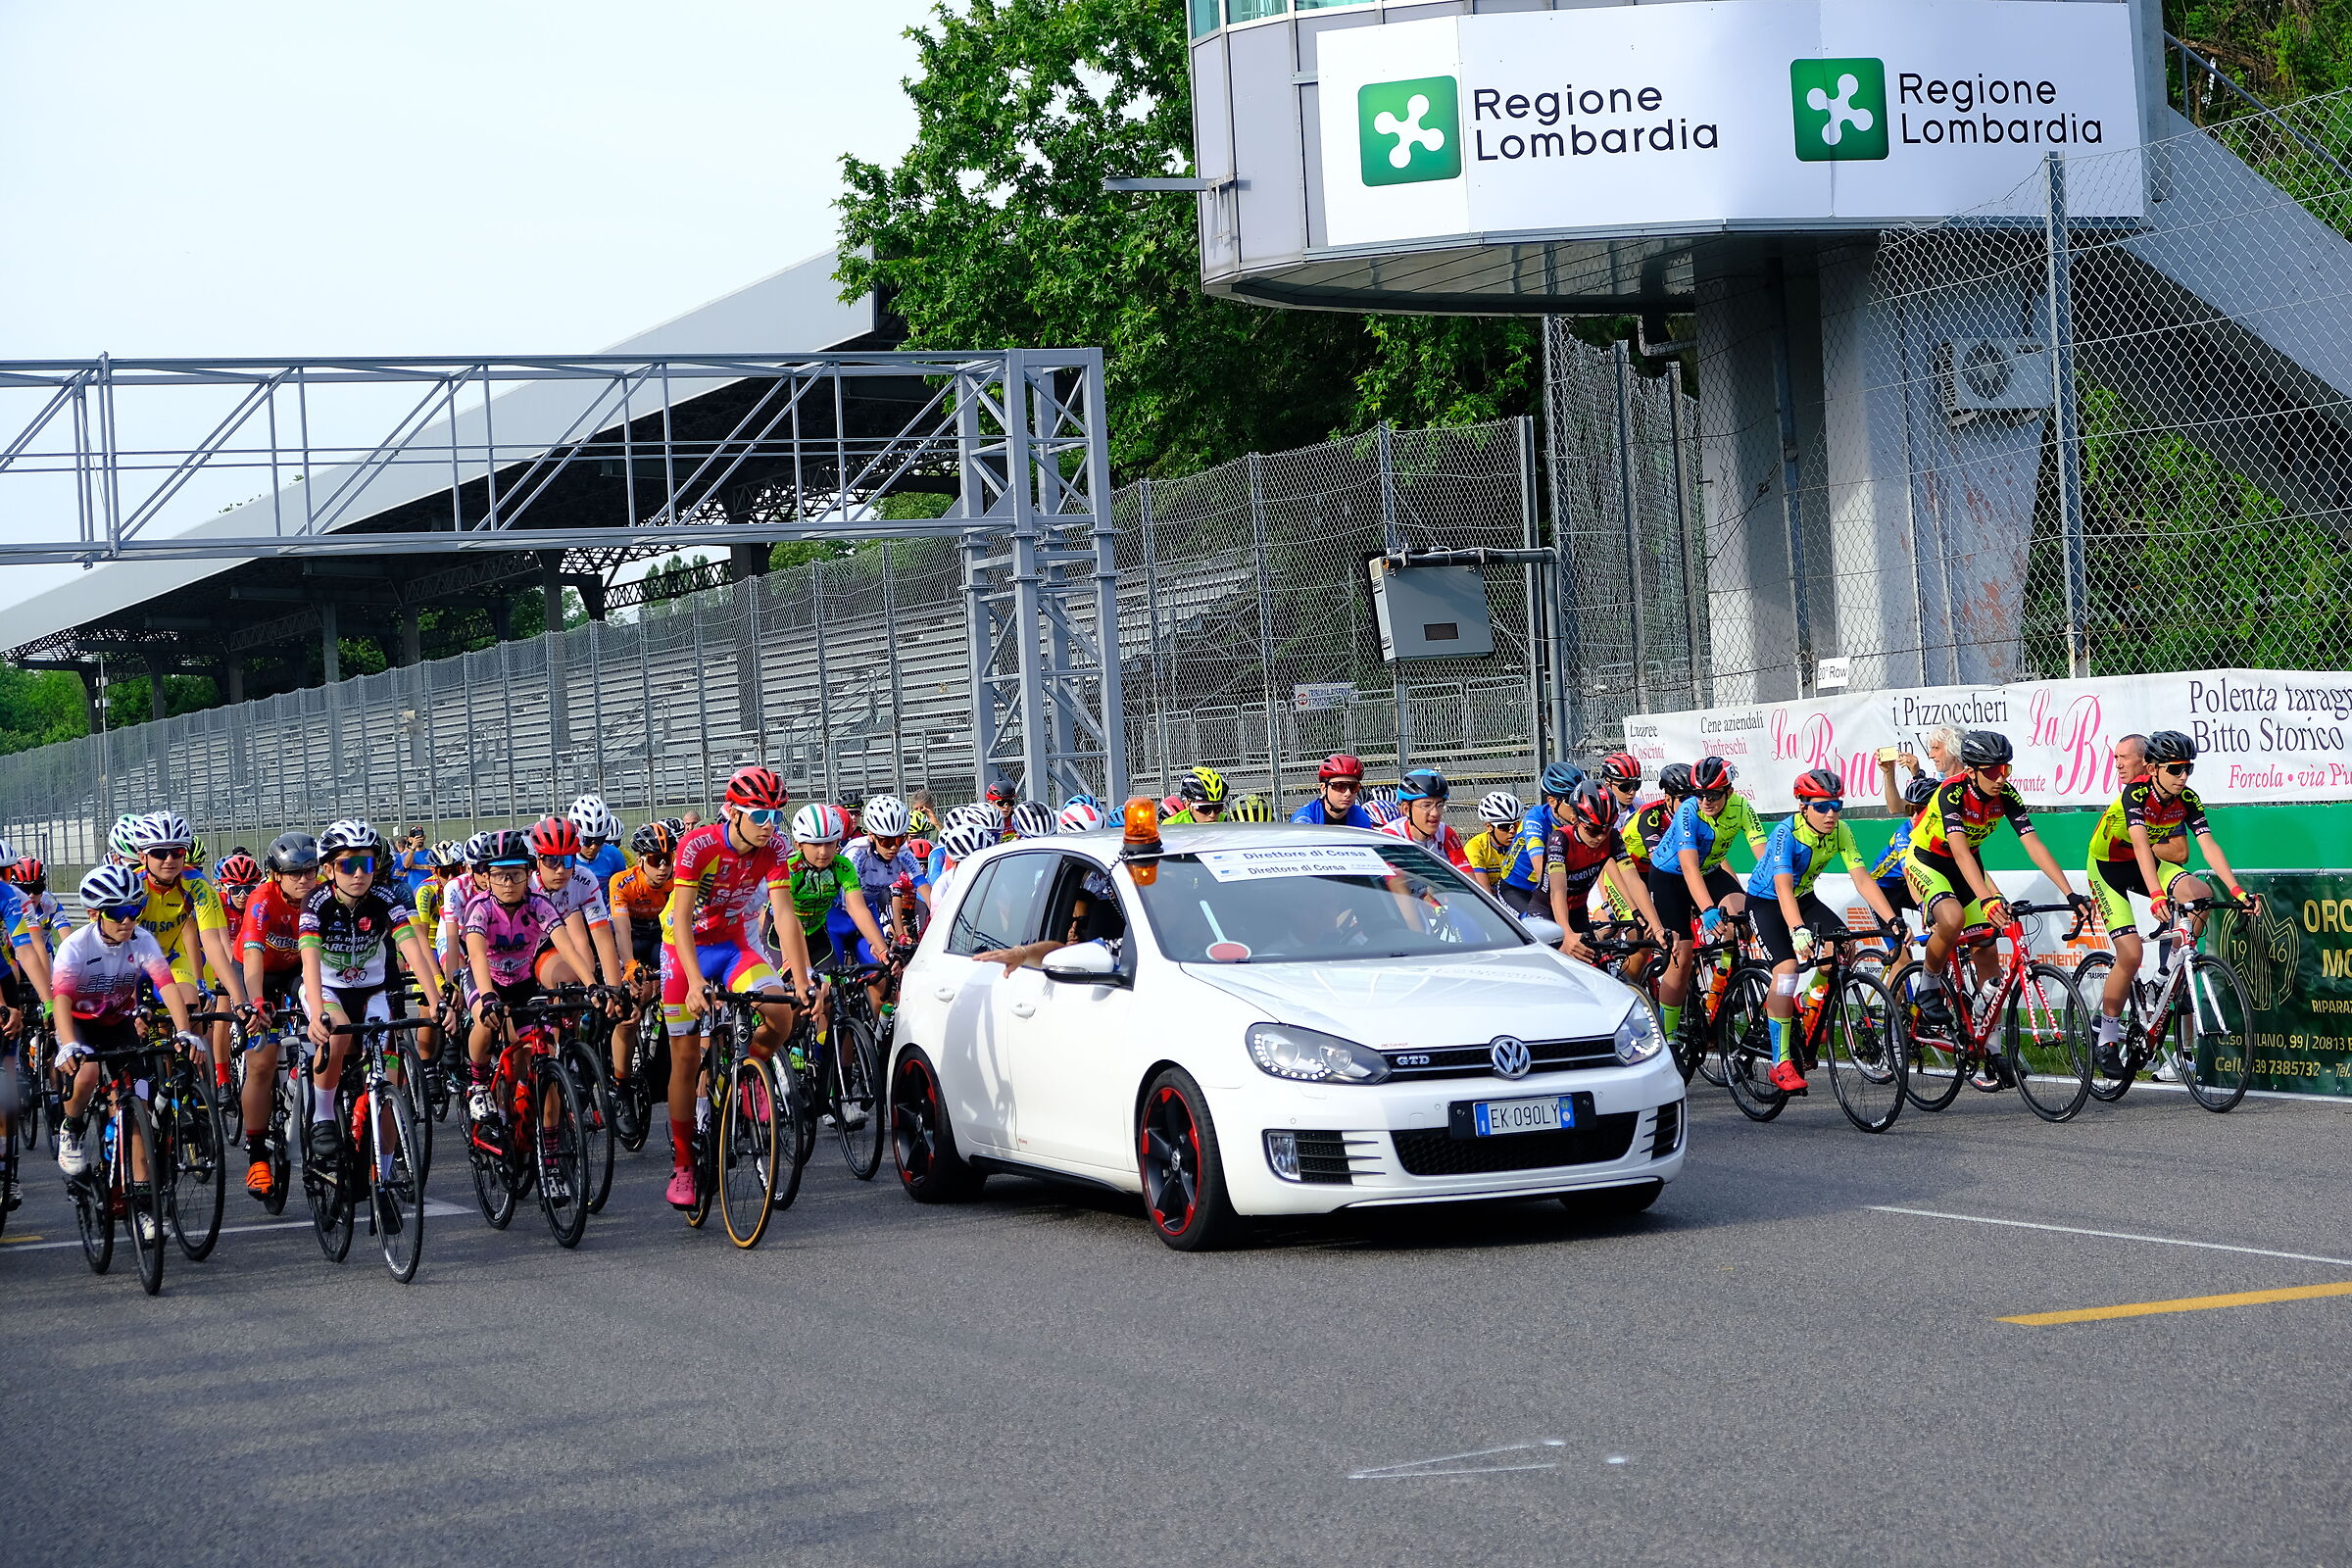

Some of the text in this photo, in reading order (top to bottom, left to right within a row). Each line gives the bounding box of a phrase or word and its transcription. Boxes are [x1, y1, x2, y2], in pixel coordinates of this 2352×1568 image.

[1474, 84, 1663, 125] Regione
[1898, 73, 2057, 113] Regione
[1476, 118, 1719, 161] Lombardia
[1901, 112, 2102, 144] Lombardia
[1829, 665, 1848, 678] Row
[2188, 677, 2278, 714] Polenta
[1904, 691, 2008, 727] Pizzoccheri
[1700, 710, 1765, 734] Cene aziendali
[2191, 716, 2345, 753] Bitto Storico
[1701, 737, 1748, 758] Rinfreschi
[2228, 763, 2284, 789] Forcola
[2297, 764, 2326, 787] via
[1243, 851, 1308, 859] Direttore
[1248, 864, 1299, 875] Direttore
[1313, 862, 1347, 871] Corsa
[2092, 880, 2114, 917] ASPIRATORI
[2036, 951, 2083, 967] arienti
[2231, 939, 2288, 962] 19 46
[2289, 1034, 2303, 1049] 99
[2312, 1035, 2345, 1051] 20813
[1396, 1054, 1431, 1065] GTD
[2269, 1059, 2322, 1077] 7385732
[2335, 1062, 2352, 1078] Tel.
[1491, 1102, 1560, 1129] EK 090LY
